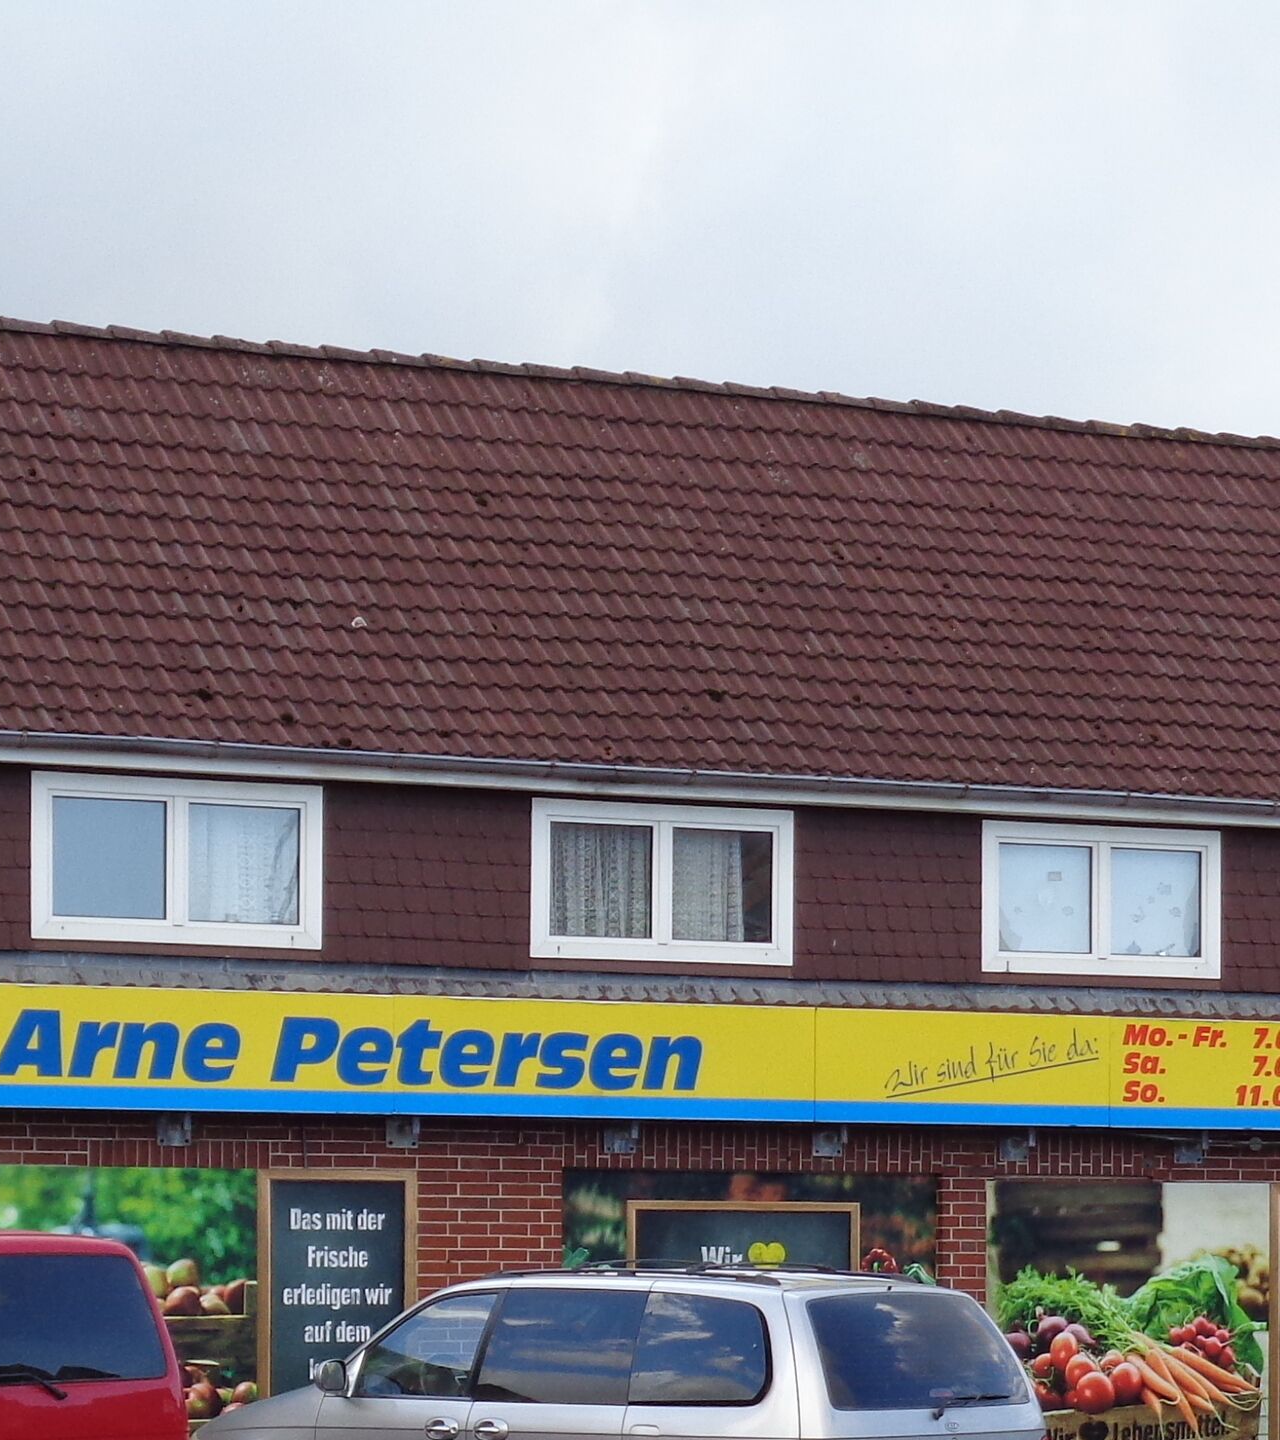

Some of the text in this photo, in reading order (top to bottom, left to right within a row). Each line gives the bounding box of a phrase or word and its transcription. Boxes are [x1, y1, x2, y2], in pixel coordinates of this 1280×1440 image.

[270, 1016, 703, 1091] Petersen
[884, 1028, 1098, 1091] Wir sind für Sie da:
[1122, 1052, 1166, 1075] Sa.
[1122, 1081, 1165, 1103] So.
[290, 1207, 386, 1231] Das mit der
[307, 1245, 369, 1268] Frische
[700, 1246, 744, 1268] Wir
[282, 1283, 393, 1310] erledigen wir
[304, 1320, 371, 1343] auf dem
